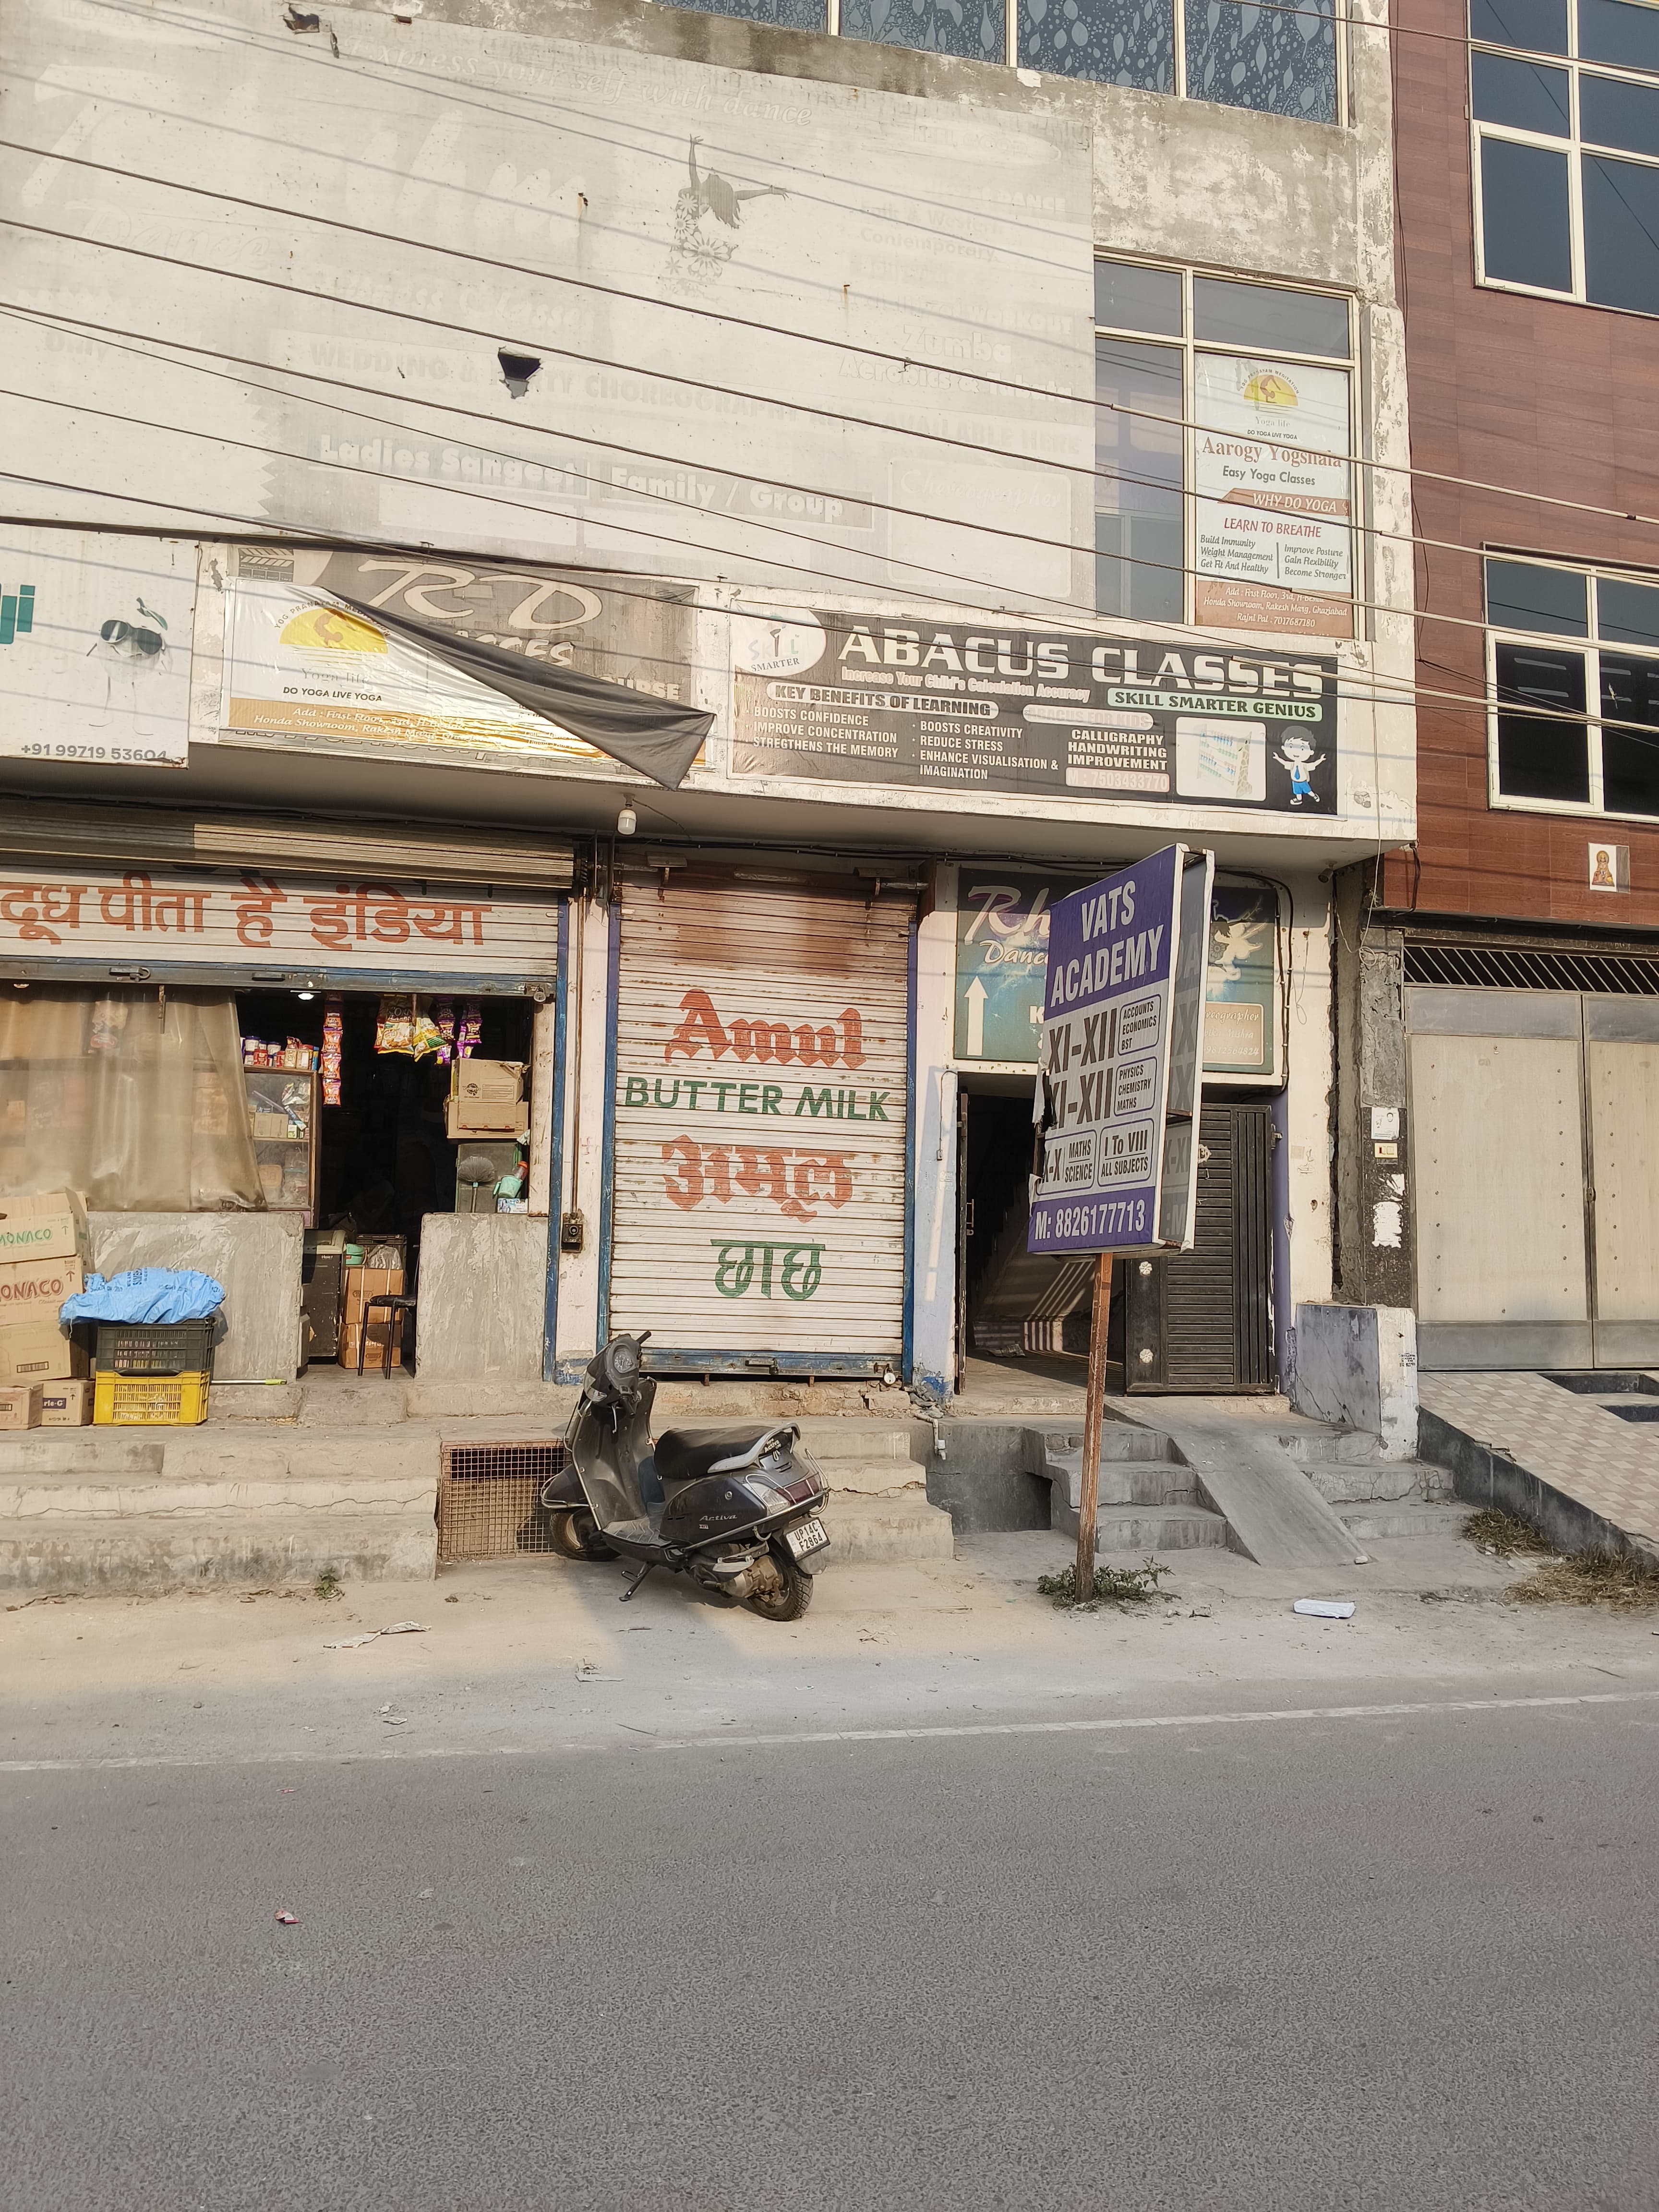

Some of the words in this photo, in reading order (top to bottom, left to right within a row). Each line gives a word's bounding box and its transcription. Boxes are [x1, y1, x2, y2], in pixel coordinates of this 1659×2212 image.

[722, 87, 813, 126] dance
[903, 324, 1012, 364] Zumba
[309, 342, 450, 380] WEDDING
[1202, 436, 1262, 463] Aarogy
[320, 433, 430, 469] Ladies
[440, 447, 577, 493] Sangeet
[1223, 465, 1246, 481] Easy
[1250, 468, 1276, 483] Yoga
[1279, 471, 1315, 485] Classes
[611, 467, 716, 509] Family
[749, 484, 843, 523] Group
[1253, 493, 1282, 507] WHY
[1284, 496, 1302, 509] DO
[1305, 498, 1337, 513] YOGA
[1224, 517, 1258, 532] LEARN
[1261, 521, 1273, 533] TO
[1276, 523, 1322, 538] BREATHE
[1200, 534, 1220, 544] Build
[1222, 536, 1256, 550] Immunity
[1284, 544, 1314, 555] Improve
[1316, 546, 1343, 557] Posture
[1201, 546, 1226, 558] Weight
[1227, 549, 1273, 562] Management
[1284, 555, 1301, 565] Gain
[1303, 556, 1339, 569] Flexibility
[1201, 559, 1213, 568] Get
[1225, 561, 1239, 570] And
[1241, 562, 1269, 575] Healthy
[1285, 567, 1312, 577] Become
[1314, 569, 1347, 581] Stronger
[1226, 587, 1239, 596] Add
[1204, 596, 1226, 607] Honda
[1265, 601, 1289, 612] Rakesh
[1312, 605, 1348, 617] Ghaziabad
[274, 615, 289, 629] YOG
[1257, 613, 1269, 623] Pal
[1274, 616, 1316, 627] 7017687180
[751, 657, 800, 672] SMARTER
[837, 625, 1070, 680] ABACUS
[1091, 646, 1323, 699] CLASSES
[301, 688, 329, 697] YOGA
[332, 690, 352, 699] LIVE
[355, 693, 383, 701] YOGA
[841, 666, 893, 686] Increase
[896, 671, 923, 688] Your
[968, 677, 1034, 697] Calculation
[1036, 683, 1091, 704] Accuracy
[775, 685, 805, 700] KEY
[810, 687, 886, 708] BENEFITS
[890, 696, 910, 710] OF
[914, 697, 991, 717] LEARNING
[1114, 691, 1164, 708] SKILL
[1168, 695, 1248, 713] SMARTER
[1253, 701, 1316, 719] GENIUS
[254, 714, 292, 726] Honda
[292, 707, 317, 717] Add
[754, 706, 797, 721] BOOSTS
[800, 709, 869, 727] CONFIDENCE
[753, 721, 805, 737] IMPROVE
[807, 724, 898, 744] CONCENTRATION
[920, 721, 961, 735] BOOSTS
[963, 723, 1023, 739] CREATIVITY
[1070, 729, 1164, 747] CALLIGRAPHY
[21, 743, 50, 756] +91
[55, 745, 106, 758] 99719
[753, 735, 823, 752] STREGTHENS
[826, 741, 847, 755] THE
[850, 744, 899, 759] MEMORY
[920, 735, 962, 750] REDUCE
[964, 738, 1003, 752] STRESS
[1068, 741, 1168, 758] HANDWRITING
[920, 749, 969, 765] ENHANCE
[971, 753, 1047, 769] VISUALISATION
[1050, 758, 1059, 770] &
[1067, 754, 1168, 771] IMPROVEMENT
[919, 765, 988, 780] IMAGINATION
[1090, 770, 1168, 790] 7503433770
[0, 882, 87, 946] दूध
[98, 870, 212, 934] पीता
[230, 876, 299, 948] है
[303, 881, 493, 951] इंडिया
[1081, 880, 1137, 943] VATS
[1050, 924, 1165, 1009] ACADEMY
[1123, 1001, 1154, 1020] ACCOUNTS
[1205, 1007, 1259, 1025] reographer
[664, 987, 867, 1070] Amul
[1122, 1015, 1157, 1035] ECONOMICS
[1048, 1008, 1118, 1076] XI-XII
[1121, 1038, 1133, 1051] BST
[1119, 1064, 1144, 1081] PHYSICS
[1118, 1078, 1152, 1096] CHEMISTRY
[625, 1076, 783, 1116] BUTTER
[794, 1086, 891, 1121] MILK
[1117, 1097, 1137, 1112] MATHS
[1069, 1139, 1091, 1159] MATHS
[1112, 1135, 1124, 1155] To
[1128, 1129, 1148, 1153] VIII
[1040, 1148, 1062, 1184] X-X
[1065, 1163, 1093, 1183] SCIENCE
[1101, 1163, 1113, 1178] ALL
[1114, 1156, 1149, 1176] SUBJECTS
[661, 1134, 853, 1224] अमूल
[1055, 1199, 1145, 1238] 8826177713
[710, 1238, 826, 1301] छाछ
[0, 1279, 62, 1300] ONACO
